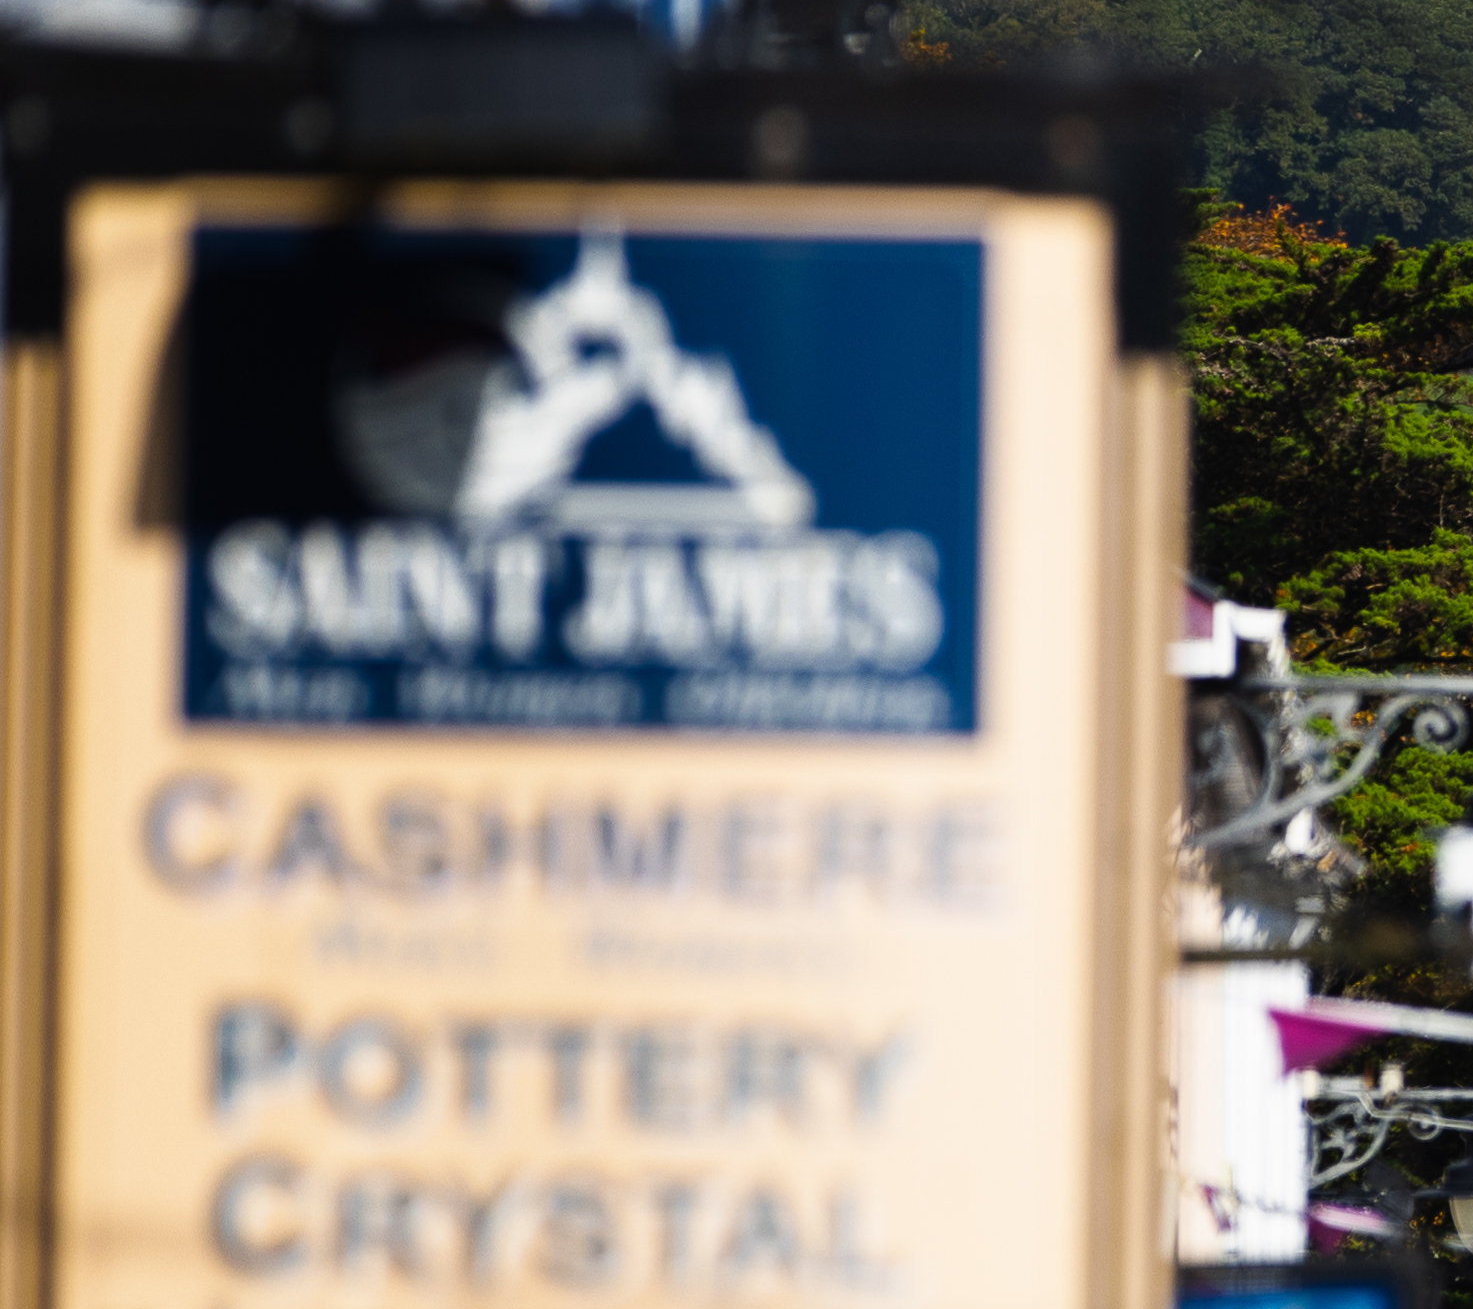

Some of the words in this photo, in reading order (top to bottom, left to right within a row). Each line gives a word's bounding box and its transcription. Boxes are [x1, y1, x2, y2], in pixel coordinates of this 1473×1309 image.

[208, 522, 556, 653] SAINT
[568, 531, 948, 669] JAMES
[139, 771, 1003, 907] CASHMERE
[206, 1000, 916, 1130] POTTERY
[206, 1154, 893, 1287] CRYSTAL
